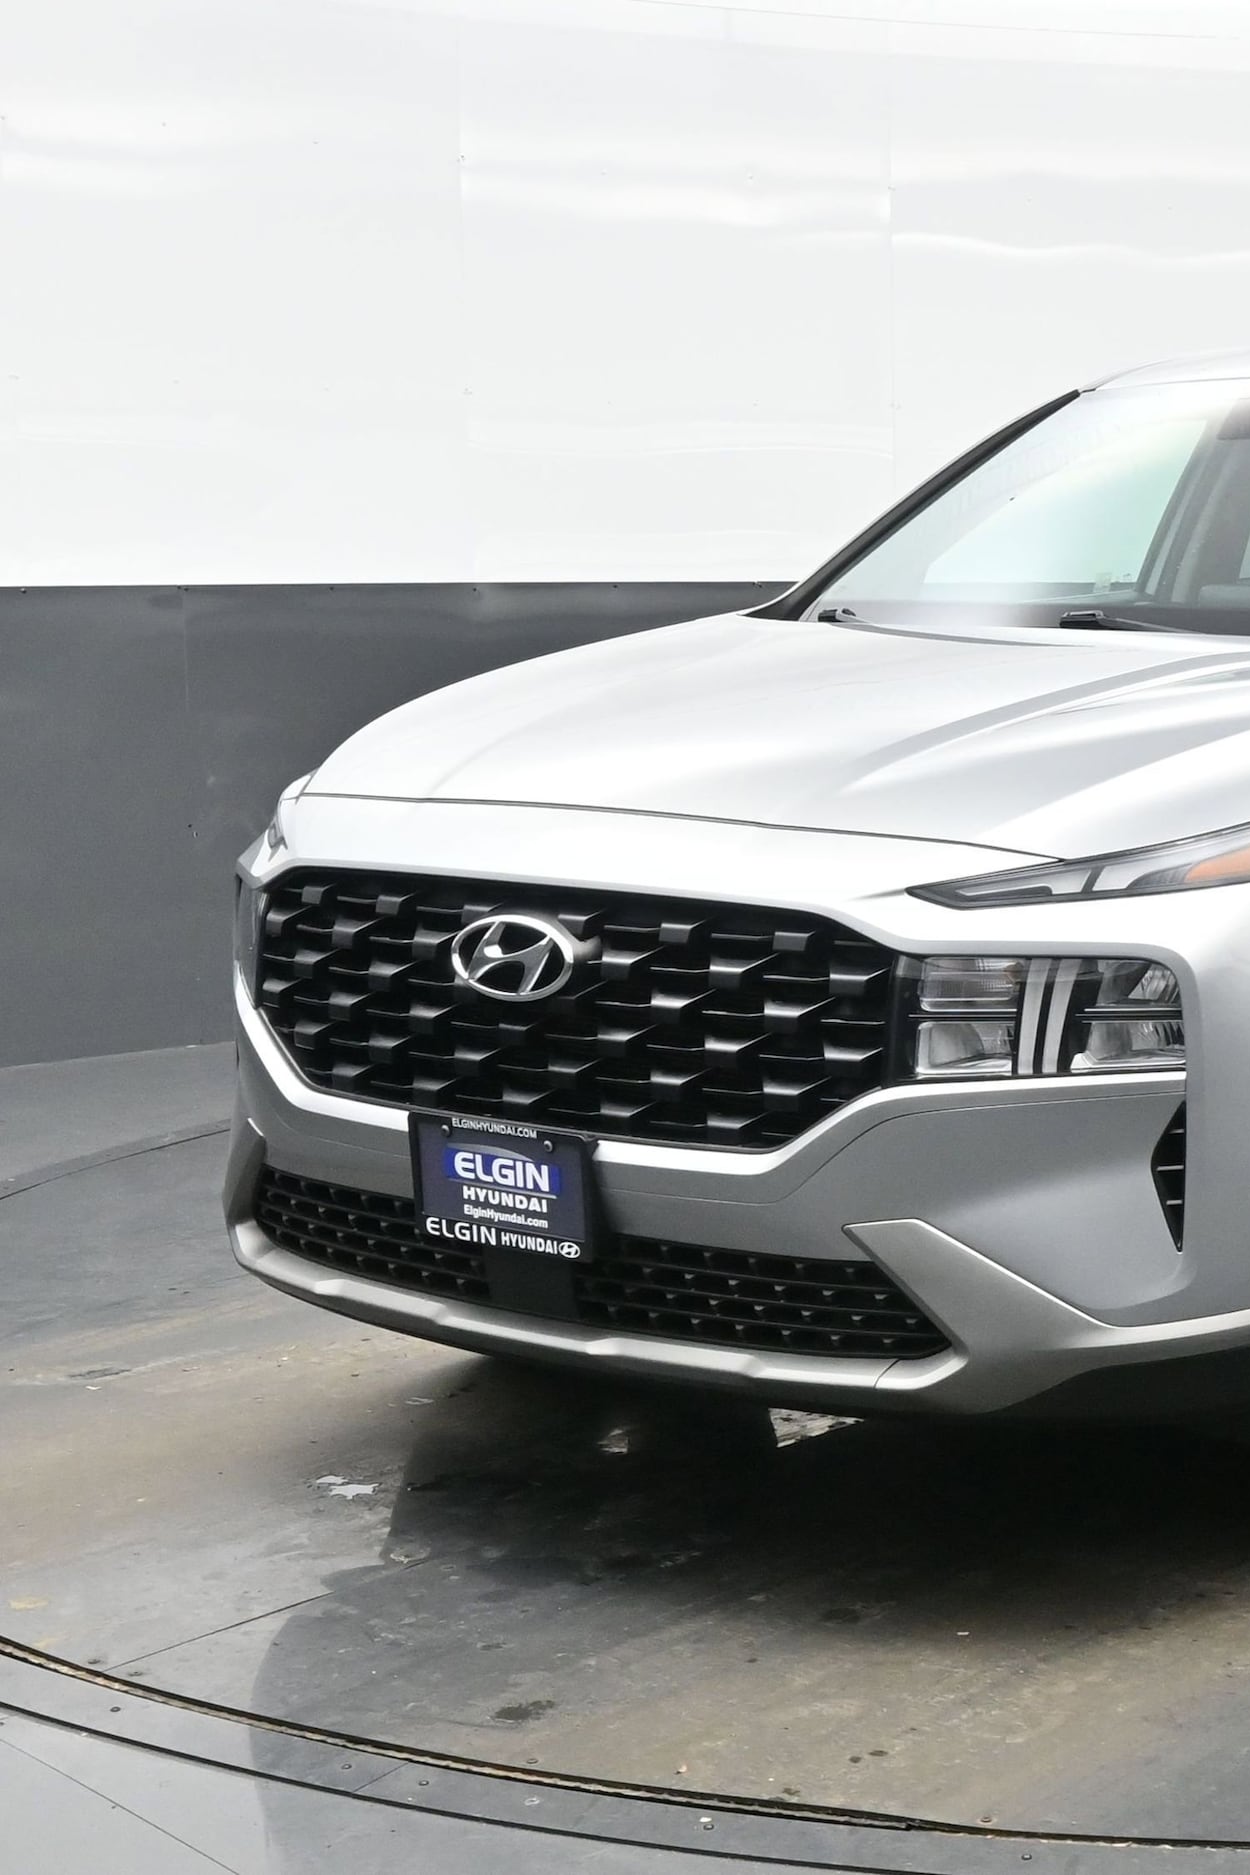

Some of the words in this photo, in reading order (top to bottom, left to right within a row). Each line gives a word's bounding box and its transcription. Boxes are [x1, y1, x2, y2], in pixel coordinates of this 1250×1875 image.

[451, 1117, 537, 1139] ELGINHYUNDAI.COM
[453, 1151, 550, 1192] ELGIN
[462, 1185, 548, 1213] HYUNDAI
[463, 1204, 549, 1229] ElginHyundai.com
[425, 1216, 497, 1246] ELGIN
[501, 1231, 558, 1255] HYUNDAI
